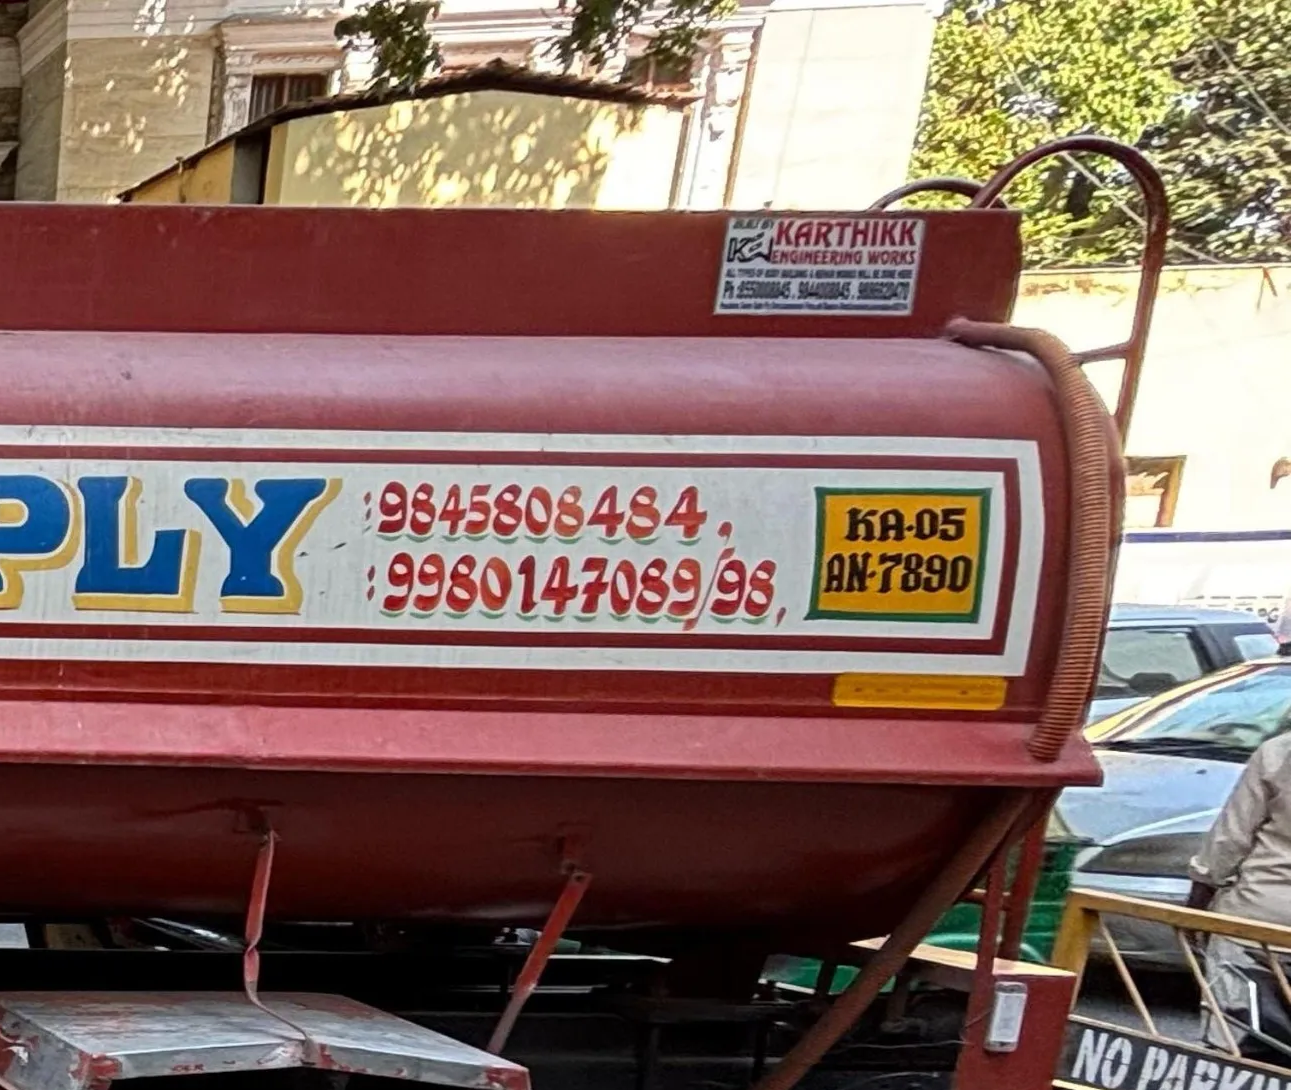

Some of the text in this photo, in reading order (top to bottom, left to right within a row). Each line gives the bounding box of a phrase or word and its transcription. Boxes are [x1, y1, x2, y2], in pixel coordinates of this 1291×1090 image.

[774, 220, 918, 248] KARTHIKK
[771, 250, 916, 266] ENGINEERING WORKS
[1071, 1028, 1133, 1089] NO
